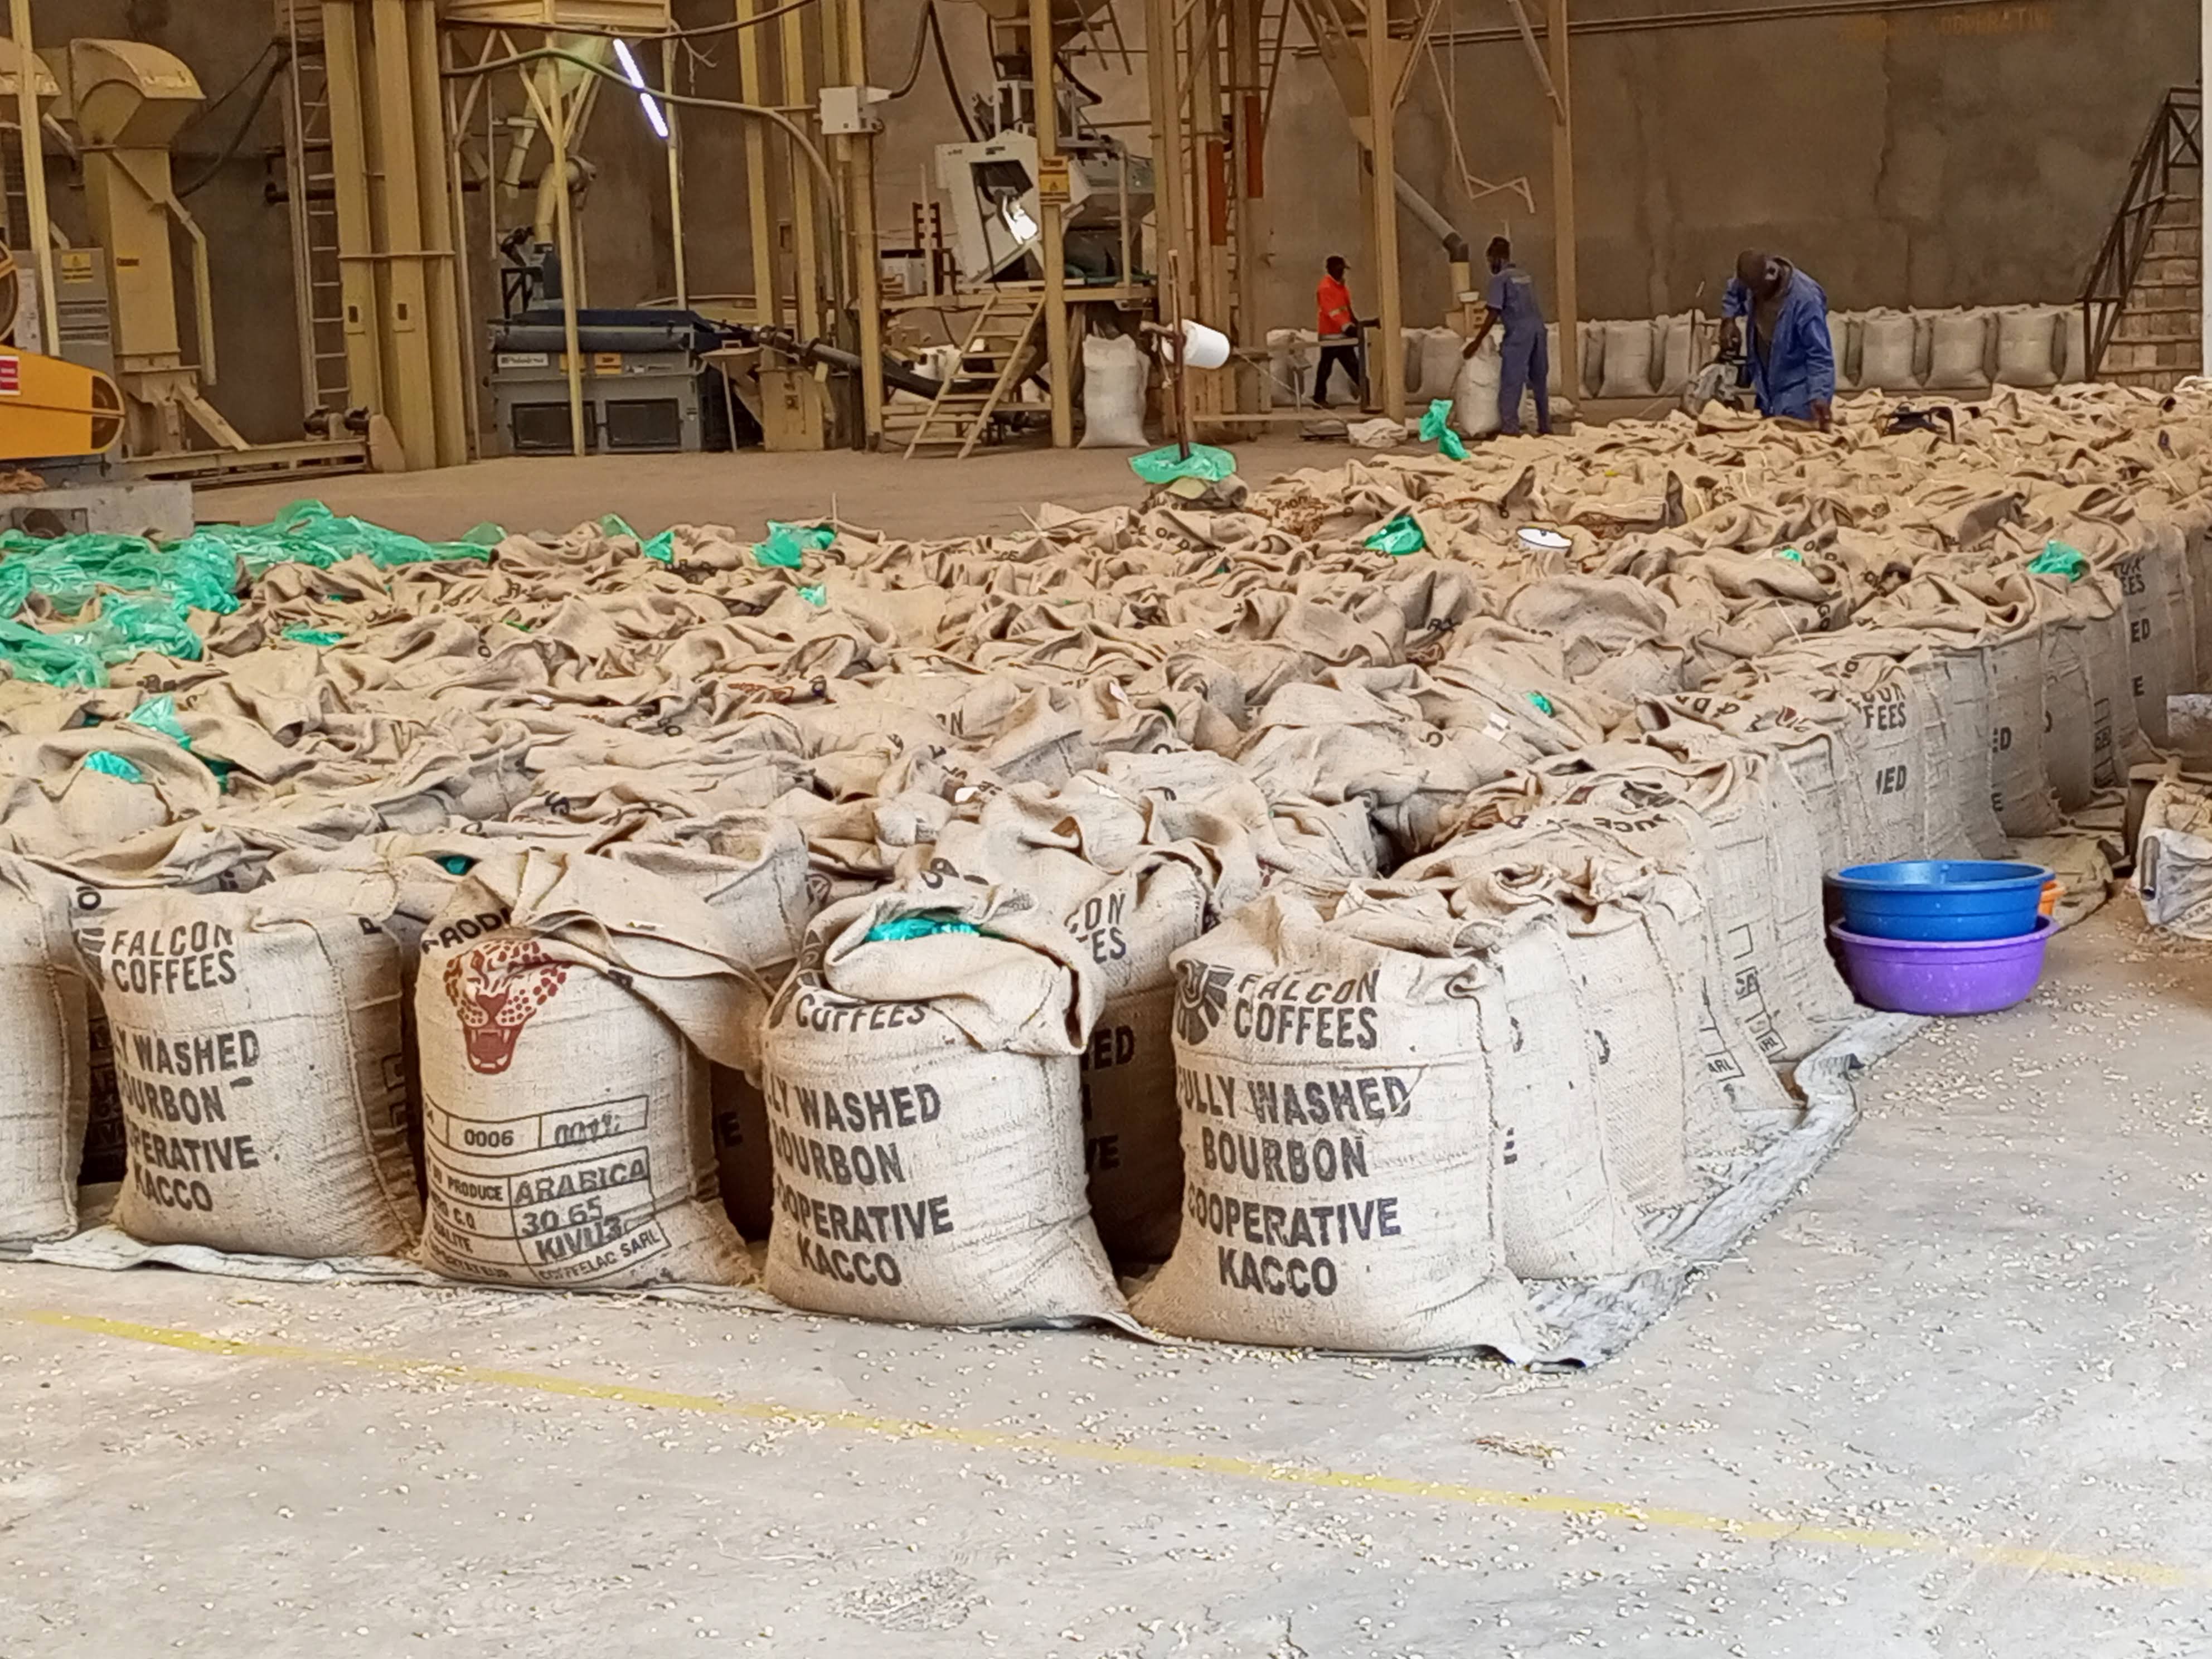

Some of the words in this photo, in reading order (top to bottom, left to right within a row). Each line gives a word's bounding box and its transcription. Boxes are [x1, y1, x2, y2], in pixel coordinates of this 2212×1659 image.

[111, 920, 233, 957] FALCON
[111, 949, 237, 995] COFFEES
[1238, 969, 1380, 1004] FALCON
[1234, 998, 1378, 1050] COFFEES
[132, 1029, 260, 1076] WASHED
[794, 1083, 941, 1133] WASHED
[1247, 1076, 1411, 1126] WASHED
[464, 1128, 514, 1148] 0006
[1201, 1126, 1369, 1184] BOURBON
[133, 1158, 213, 1212] KACCO
[448, 1175, 503, 1202] PRODUCE
[515, 1159, 646, 1205] ARABICA
[1187, 1181, 1401, 1248] COOPERATIVE
[619, 1228, 661, 1258] SARL
[797, 1231, 902, 1287] KACCO
[1218, 1245, 1337, 1298] KACCO
